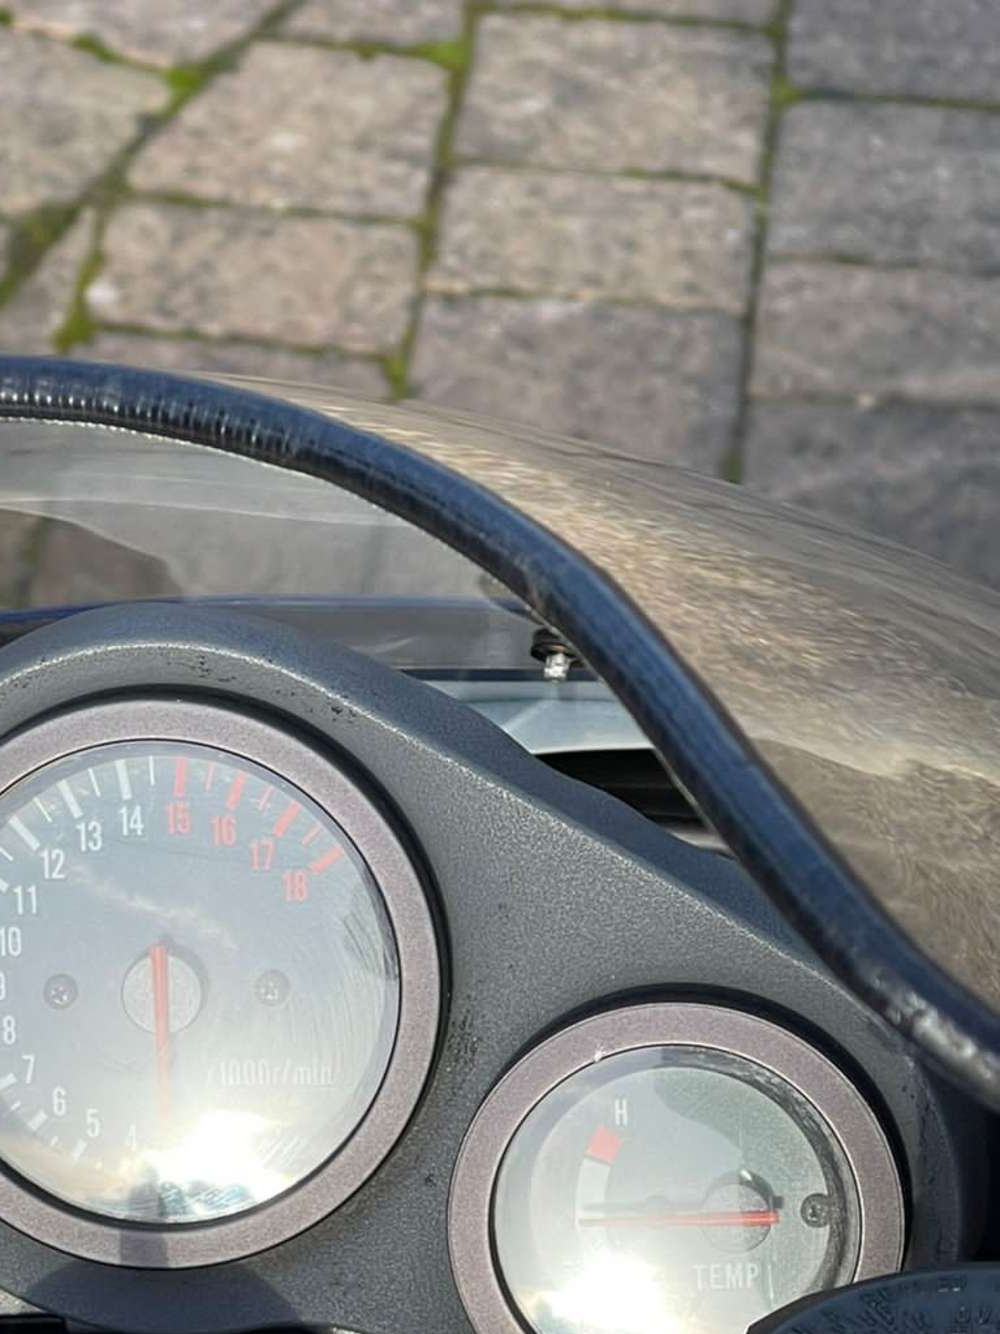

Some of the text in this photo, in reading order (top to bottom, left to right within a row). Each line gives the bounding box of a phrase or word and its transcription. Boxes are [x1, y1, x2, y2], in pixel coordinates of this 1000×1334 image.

[120, 806, 144, 835] 14
[166, 803, 192, 834] 15
[211, 815, 237, 845] 16
[76, 822, 102, 851] 13
[41, 850, 66, 879] 12
[251, 840, 274, 870] 17
[13, 885, 37, 914] 11
[283, 870, 307, 900] 18
[2, 1015, 16, 1044] 8
[22, 1055, 36, 1083] 7
[53, 1087, 66, 1116] 6
[615, 1099, 628, 1126] H
[86, 1108, 99, 1137] 5
[693, 1263, 759, 1291] TEMP
